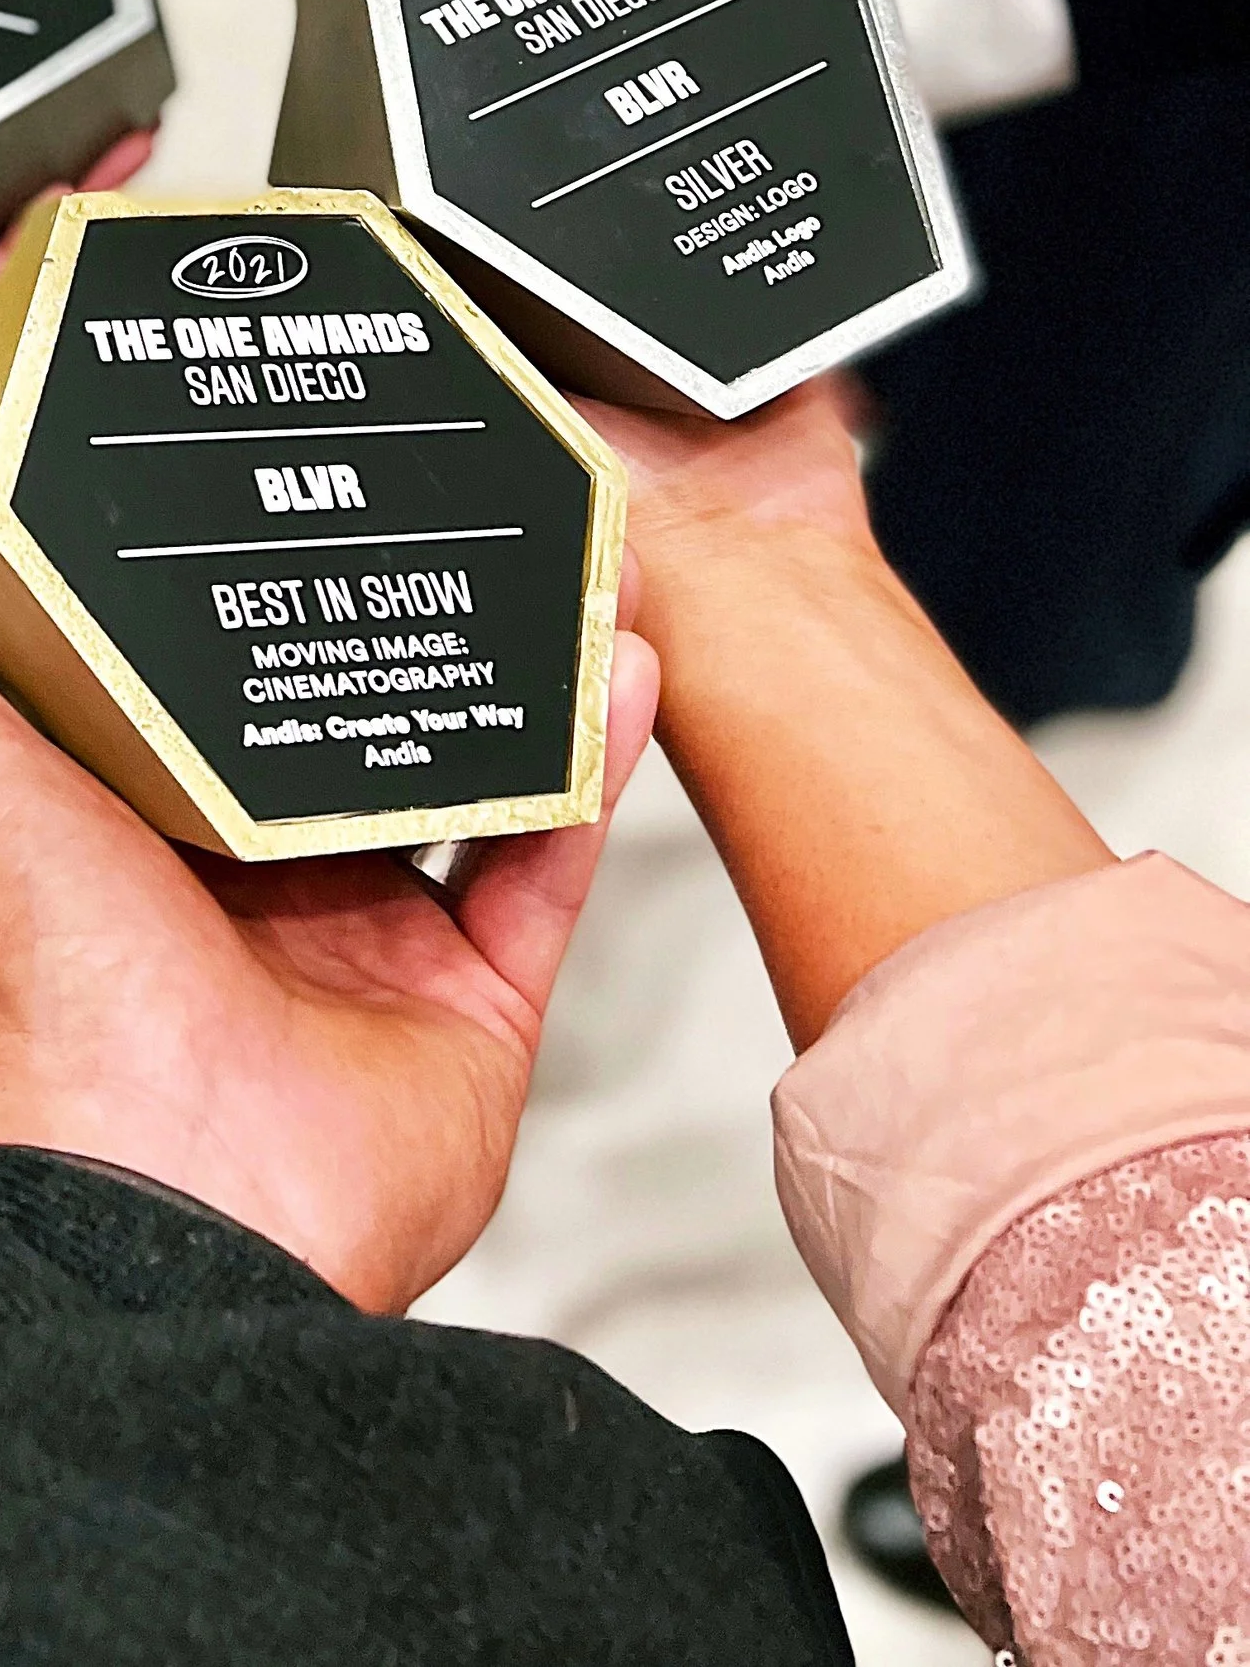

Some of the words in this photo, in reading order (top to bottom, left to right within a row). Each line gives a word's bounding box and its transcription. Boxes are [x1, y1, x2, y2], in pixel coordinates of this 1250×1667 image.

[515, 5, 581, 54] SAN
[604, 61, 700, 125] BLVR
[665, 140, 772, 210] SILVER
[674, 204, 760, 255] DESIGN:
[756, 173, 817, 213] LOGO
[202, 248, 285, 285] 2021
[723, 240, 777, 275] Andis
[772, 217, 820, 247] Logo
[763, 250, 815, 285] Andis
[85, 319, 173, 361] THE
[173, 317, 260, 358] ONE
[261, 313, 429, 356] AWARDS
[185, 365, 257, 405] SAN
[261, 362, 366, 402] DIEGO
[254, 465, 366, 512] BLVR
[212, 580, 306, 629] BEST
[314, 578, 357, 622] IN
[361, 571, 473, 619] SHOW
[252, 639, 369, 669] MOVING
[371, 632, 469, 660] IMAGE:
[243, 662, 493, 703] CINEMATOGRAPHY
[244, 719, 323, 747] Andis:
[326, 714, 410, 739] Create
[411, 709, 467, 731] Your
[469, 704, 523, 729] Way
[365, 740, 431, 768] Andis
